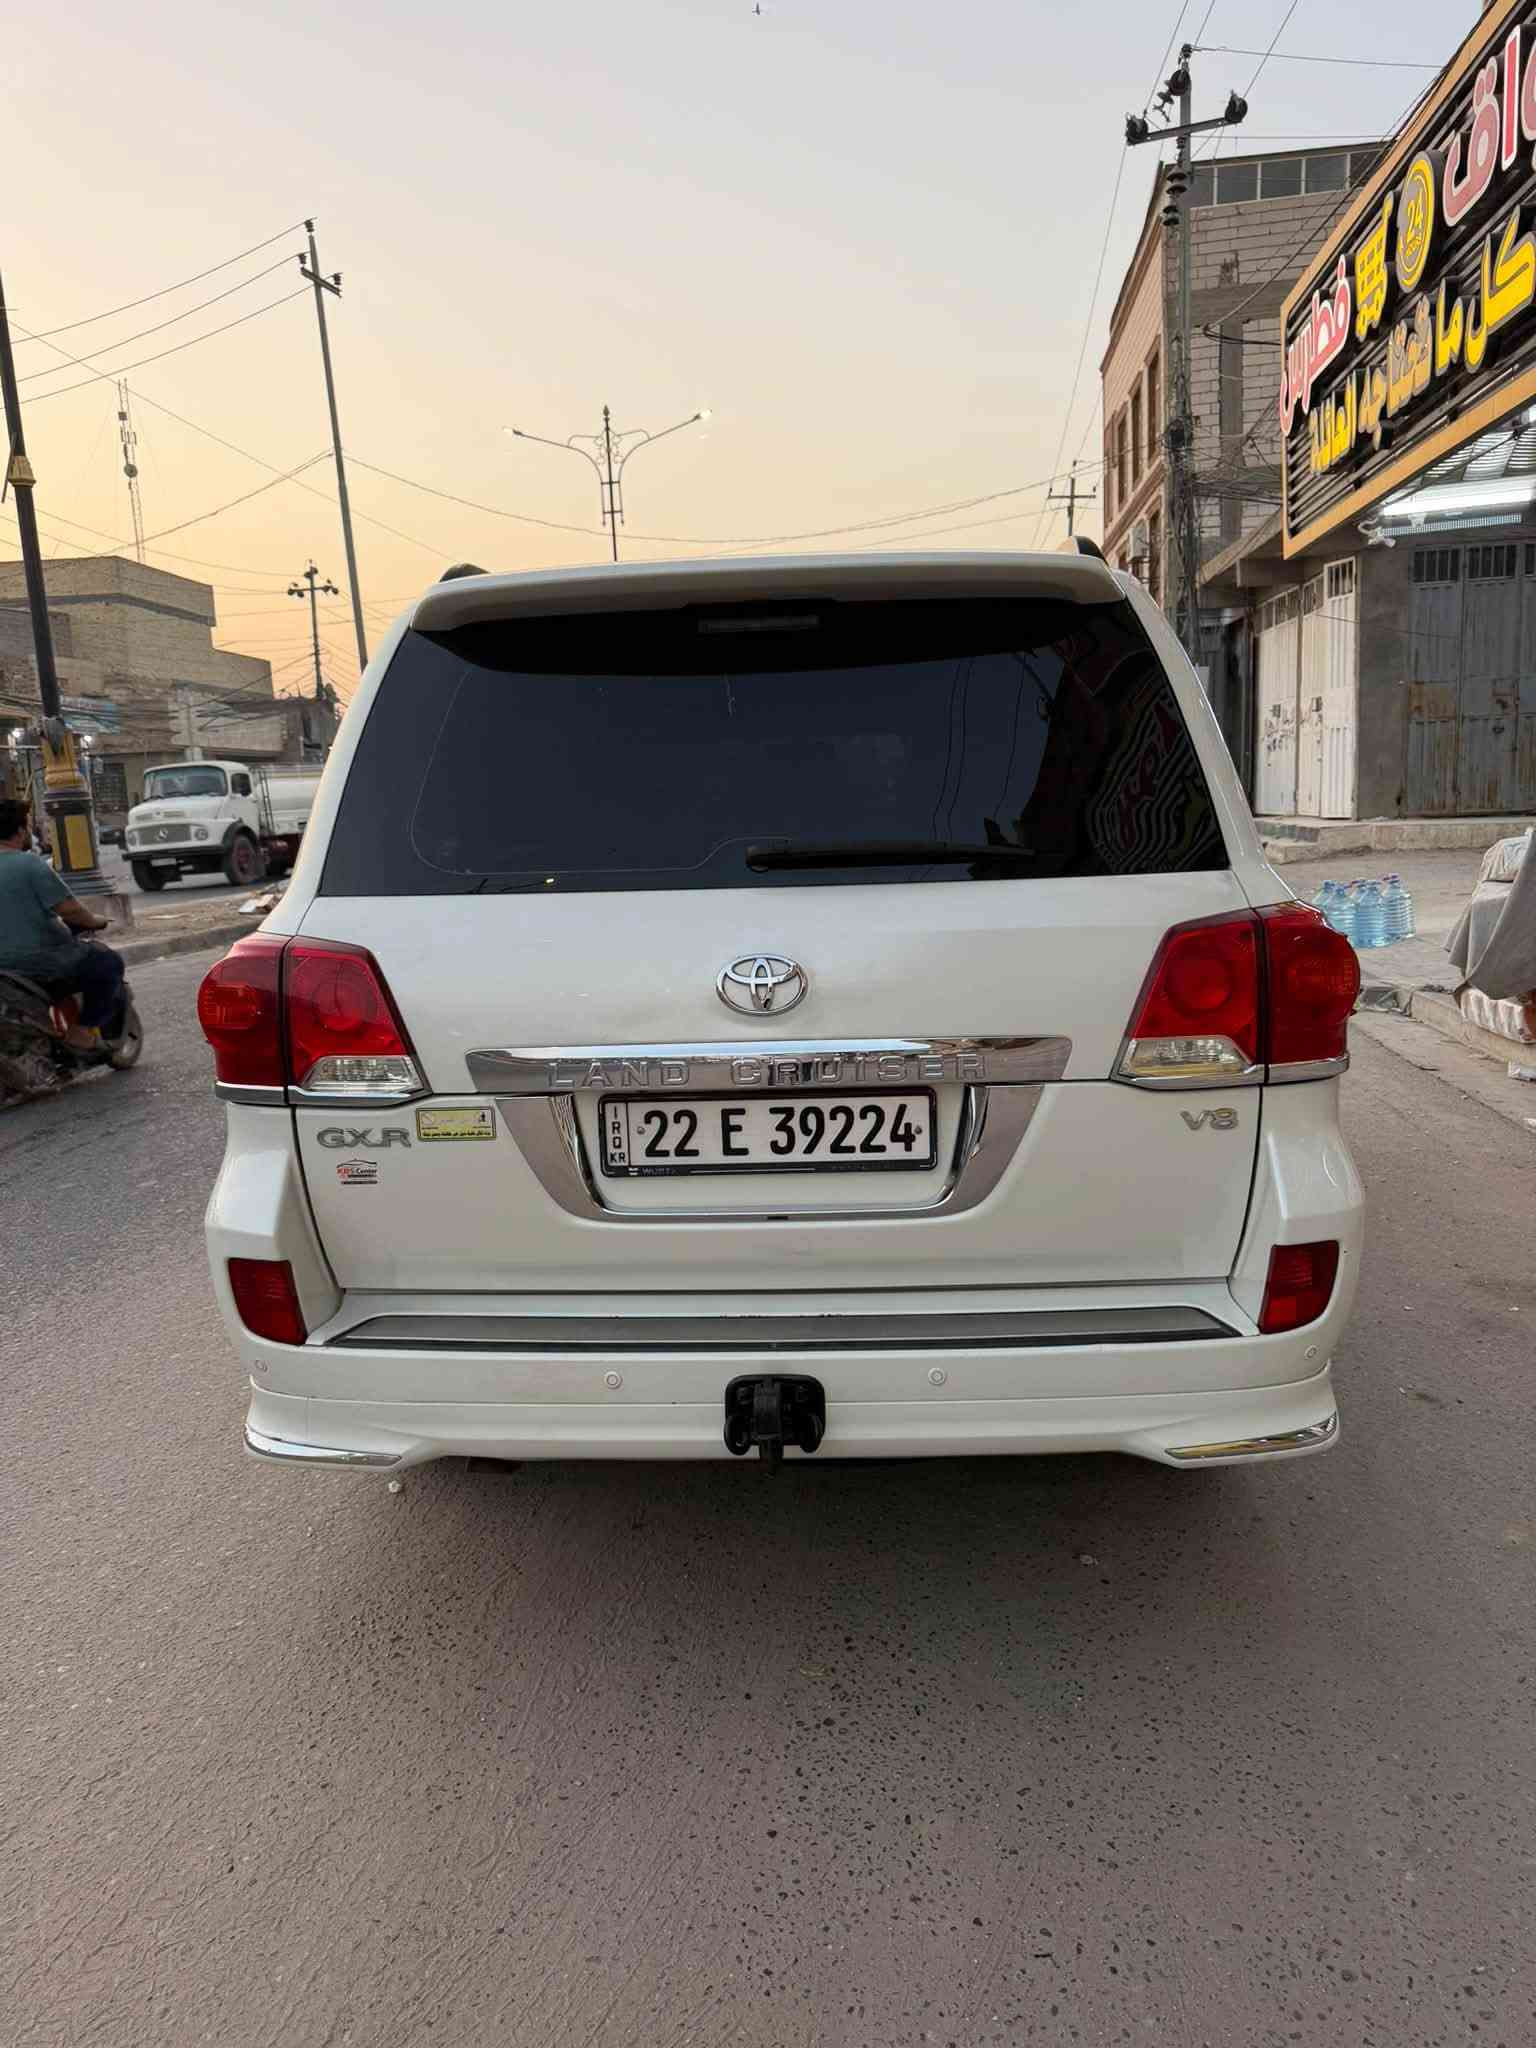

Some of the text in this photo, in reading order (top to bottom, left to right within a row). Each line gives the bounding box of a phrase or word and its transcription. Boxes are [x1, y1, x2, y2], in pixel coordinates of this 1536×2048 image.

[1407, 187, 1423, 241] 24
[1464, 204, 1536, 374] كل
[1435, 279, 1464, 377] ما
[548, 1053, 986, 1089] LAND CRUISER
[316, 1127, 412, 1148] GXR
[644, 1103, 916, 1157] 22 E 39224
[1180, 1107, 1239, 1131] V8
